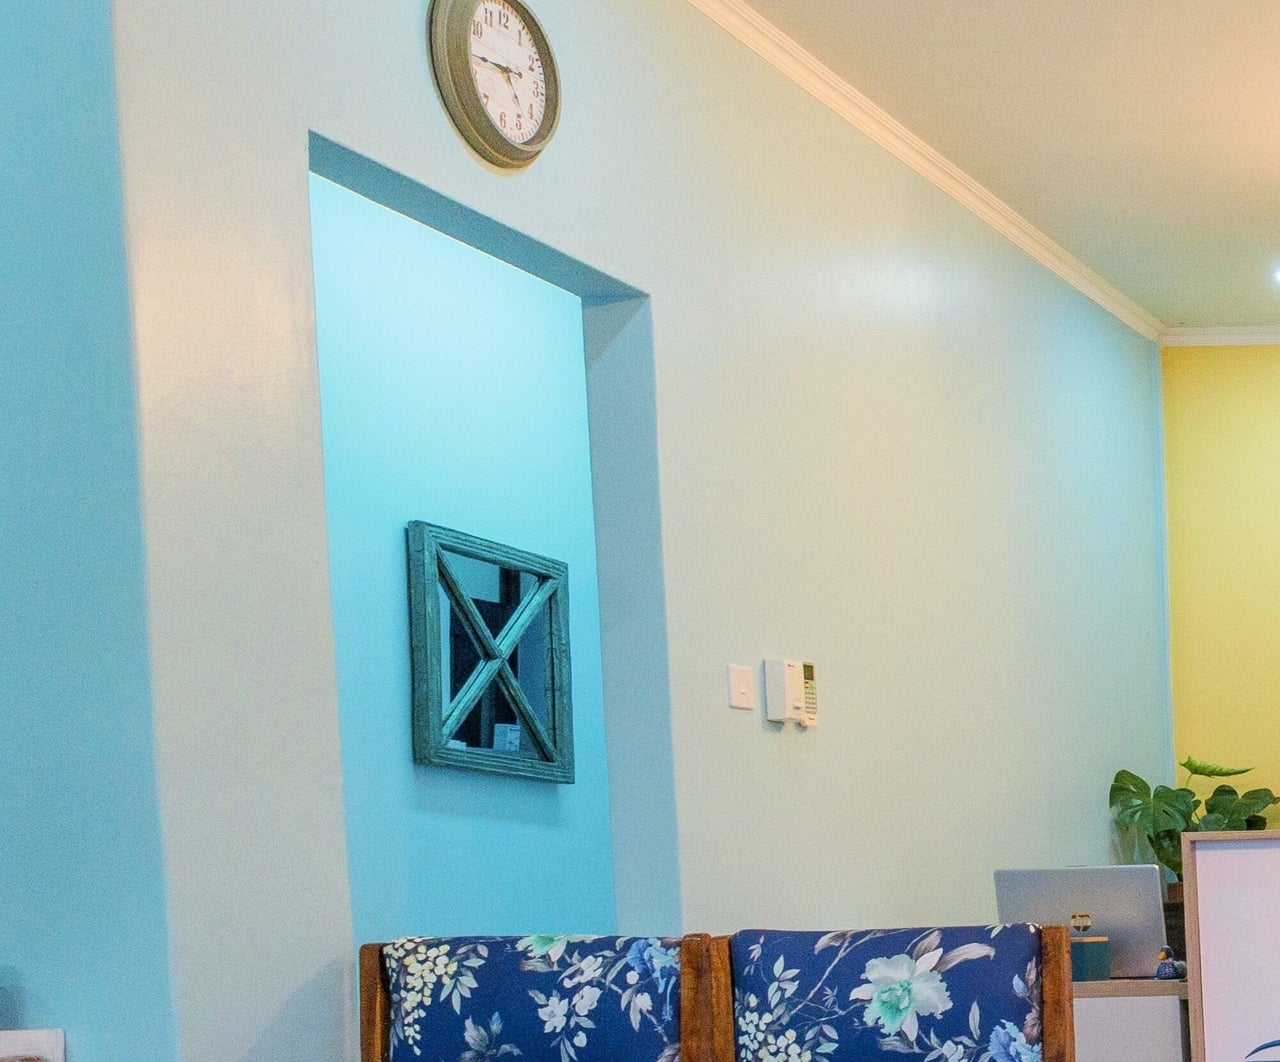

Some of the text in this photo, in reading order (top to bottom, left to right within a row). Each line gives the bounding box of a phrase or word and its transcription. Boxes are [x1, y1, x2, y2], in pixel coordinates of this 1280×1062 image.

[484, 7, 493, 28] 11
[498, 10, 510, 30] 12
[472, 19, 483, 39] 10
[527, 54, 535, 73] 2
[532, 80, 539, 98] 3
[499, 111, 507, 129] 6
[527, 103, 534, 120] 4
[515, 113, 522, 131] 5
